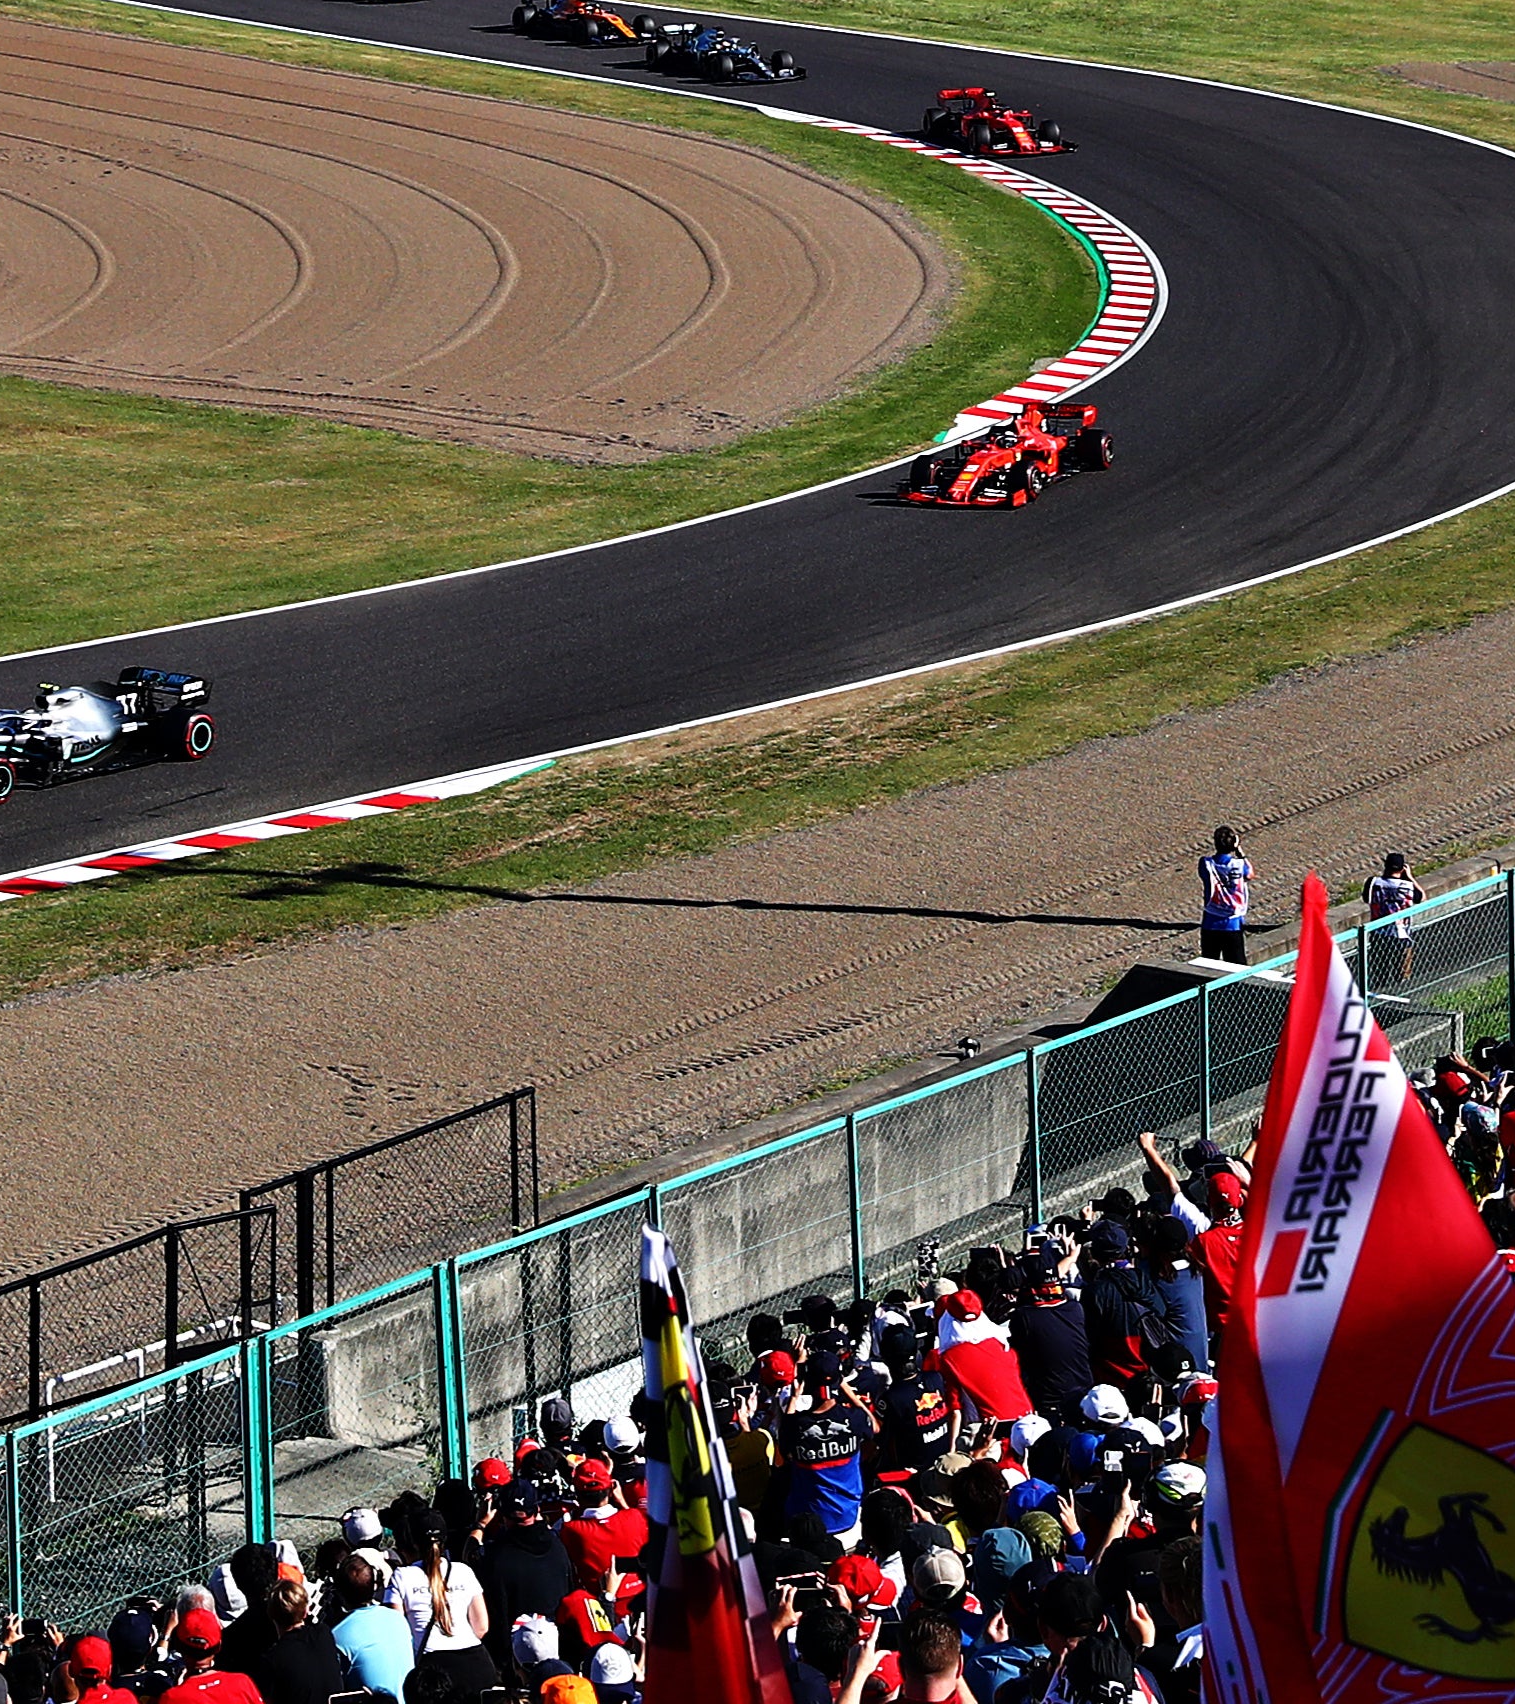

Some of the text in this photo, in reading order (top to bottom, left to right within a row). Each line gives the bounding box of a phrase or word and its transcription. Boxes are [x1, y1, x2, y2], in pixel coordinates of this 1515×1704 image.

[116, 693, 138, 715] 77
[916, 1402, 948, 1427] Red Bull
[923, 1426, 941, 1443] Mobil
[796, 1435, 857, 1460] Red Bull
